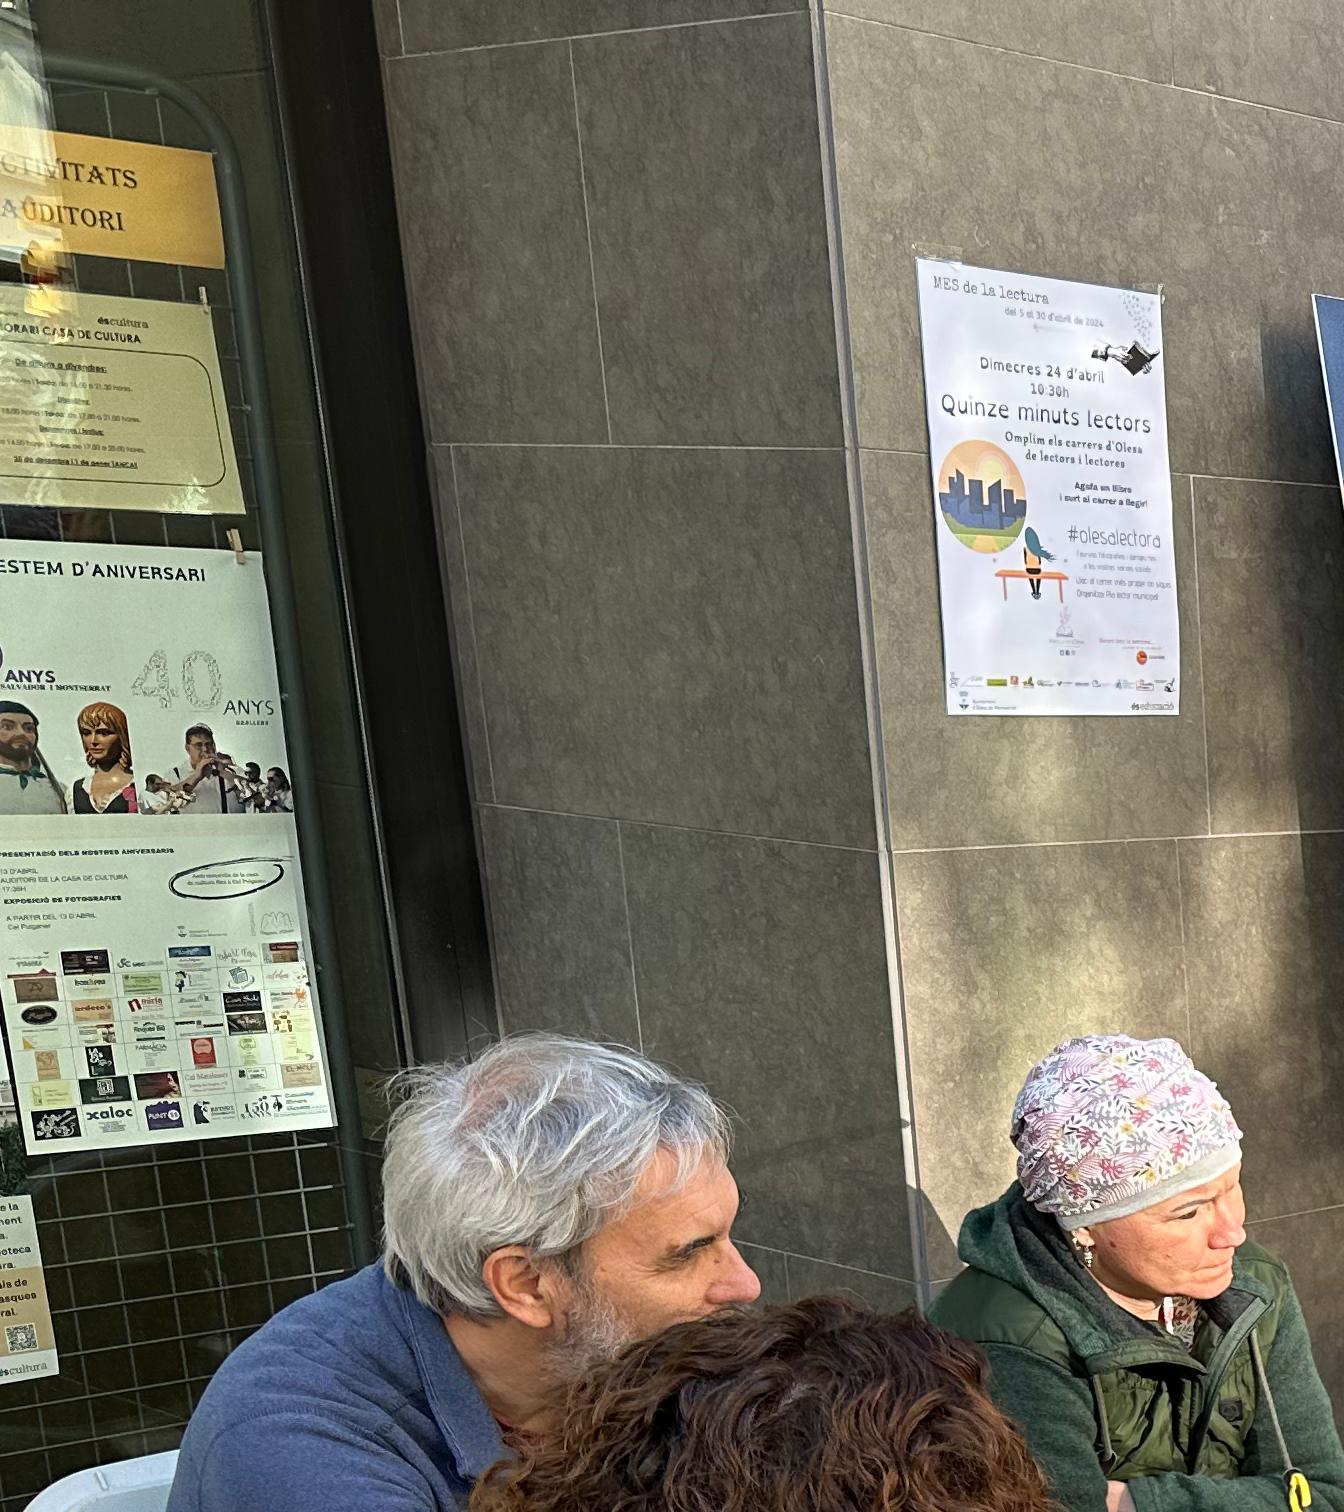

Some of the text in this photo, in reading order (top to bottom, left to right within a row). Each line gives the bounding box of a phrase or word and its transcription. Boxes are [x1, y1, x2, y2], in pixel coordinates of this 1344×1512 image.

[934, 276, 1049, 304] MES de la lectura
[0, 322, 141, 344] ORARI CASA DE CULTURA
[980, 356, 1105, 384] Dimecres 24 d'abril
[941, 394, 1151, 434] Quinze minuts lectors
[1005, 431, 1142, 454] Omplim els carrers d'Olesa
[1025, 449, 1037, 460] de
[1040, 451, 1075, 464] lectors
[1085, 454, 1125, 468] lectores
[1067, 524, 1161, 548] #olesalectora
[0, 559, 206, 582] ESTEM D'ANIVERSARI
[5, 669, 56, 683] ANYS
[131, 650, 223, 710] 40
[223, 700, 274, 716] ANYS
[86, 1106, 133, 1120] xaloc
[9, 1203, 19, 1211] la
[0, 1246, 31, 1256] oteca
[14, 1279, 27, 1287] de
